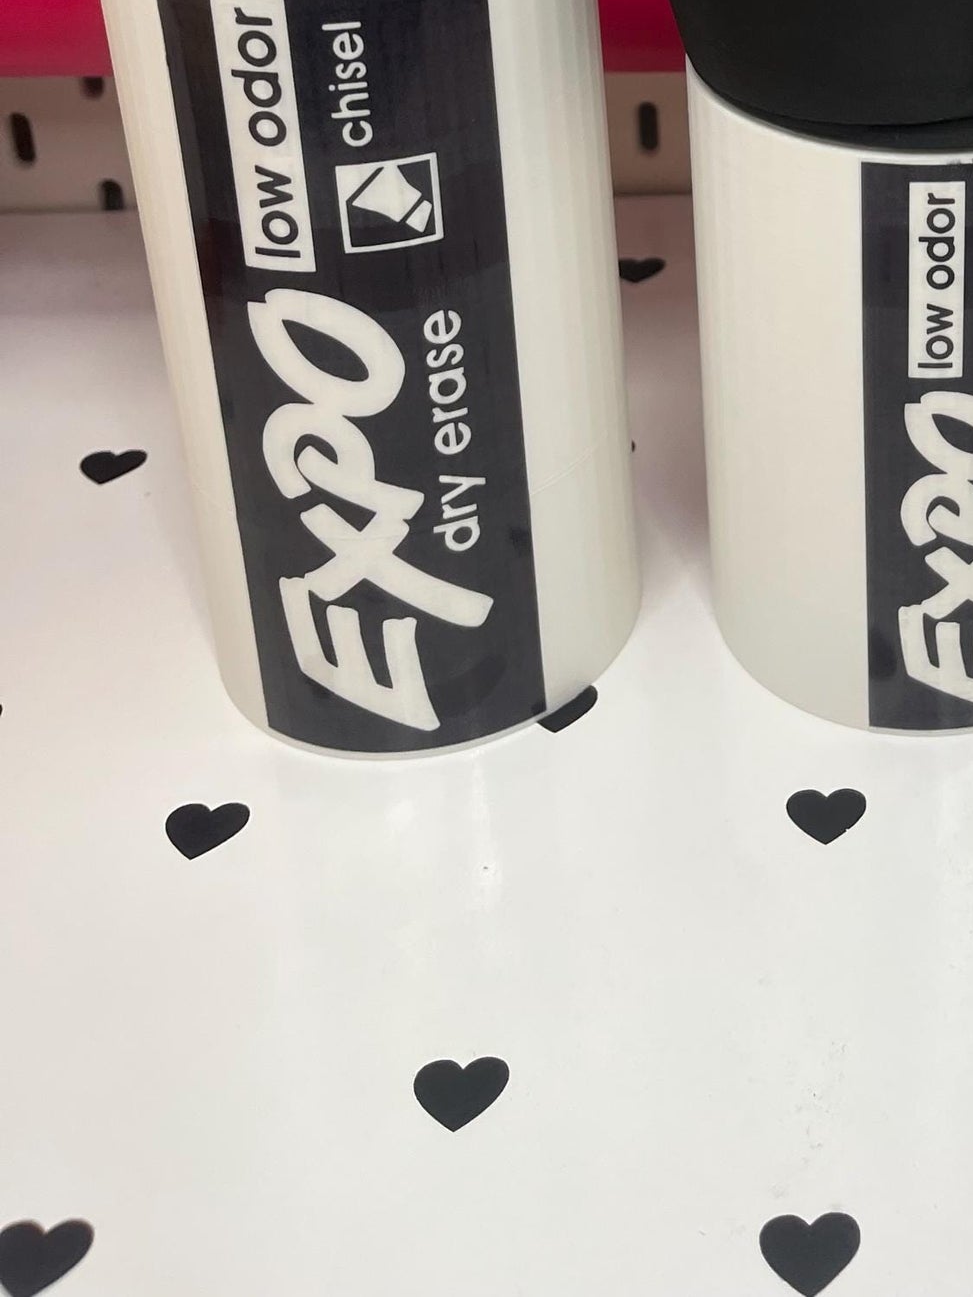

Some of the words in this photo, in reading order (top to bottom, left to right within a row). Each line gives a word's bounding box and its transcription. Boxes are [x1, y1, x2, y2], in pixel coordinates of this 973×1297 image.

[231, 6, 287, 147] odor
[321, 21, 374, 148] chisel
[254, 165, 301, 258] low
[918, 192, 956, 290] odor
[423, 309, 472, 455] erase
[918, 303, 954, 369] low
[433, 475, 486, 552] dry
